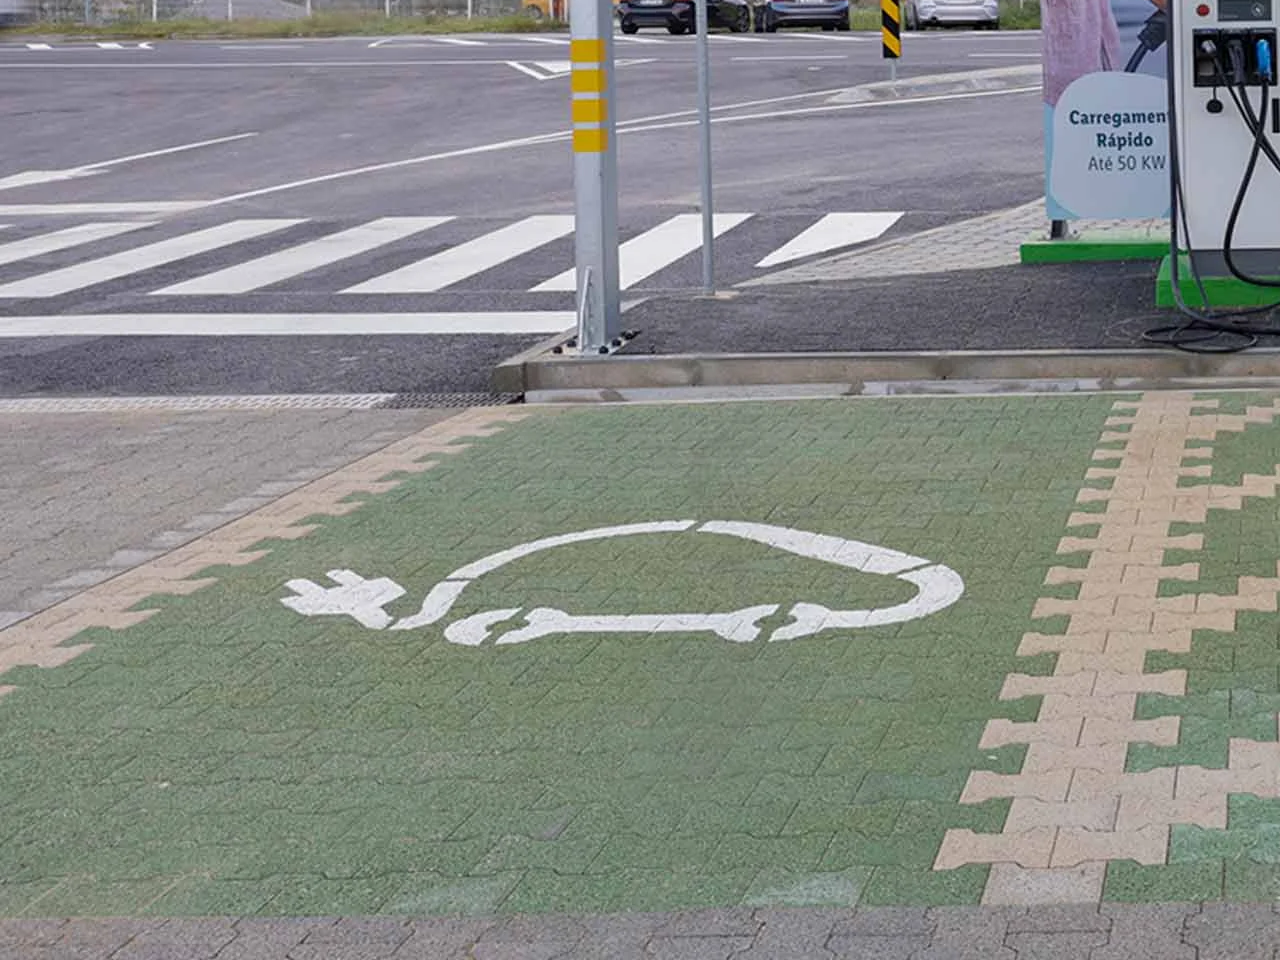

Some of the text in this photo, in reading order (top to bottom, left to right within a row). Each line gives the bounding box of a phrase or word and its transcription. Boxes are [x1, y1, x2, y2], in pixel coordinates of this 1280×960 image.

[1069, 110, 1168, 128] Carregamen
[1096, 131, 1153, 151] Rápido
[1088, 155, 1166, 171] Até 50 KW
